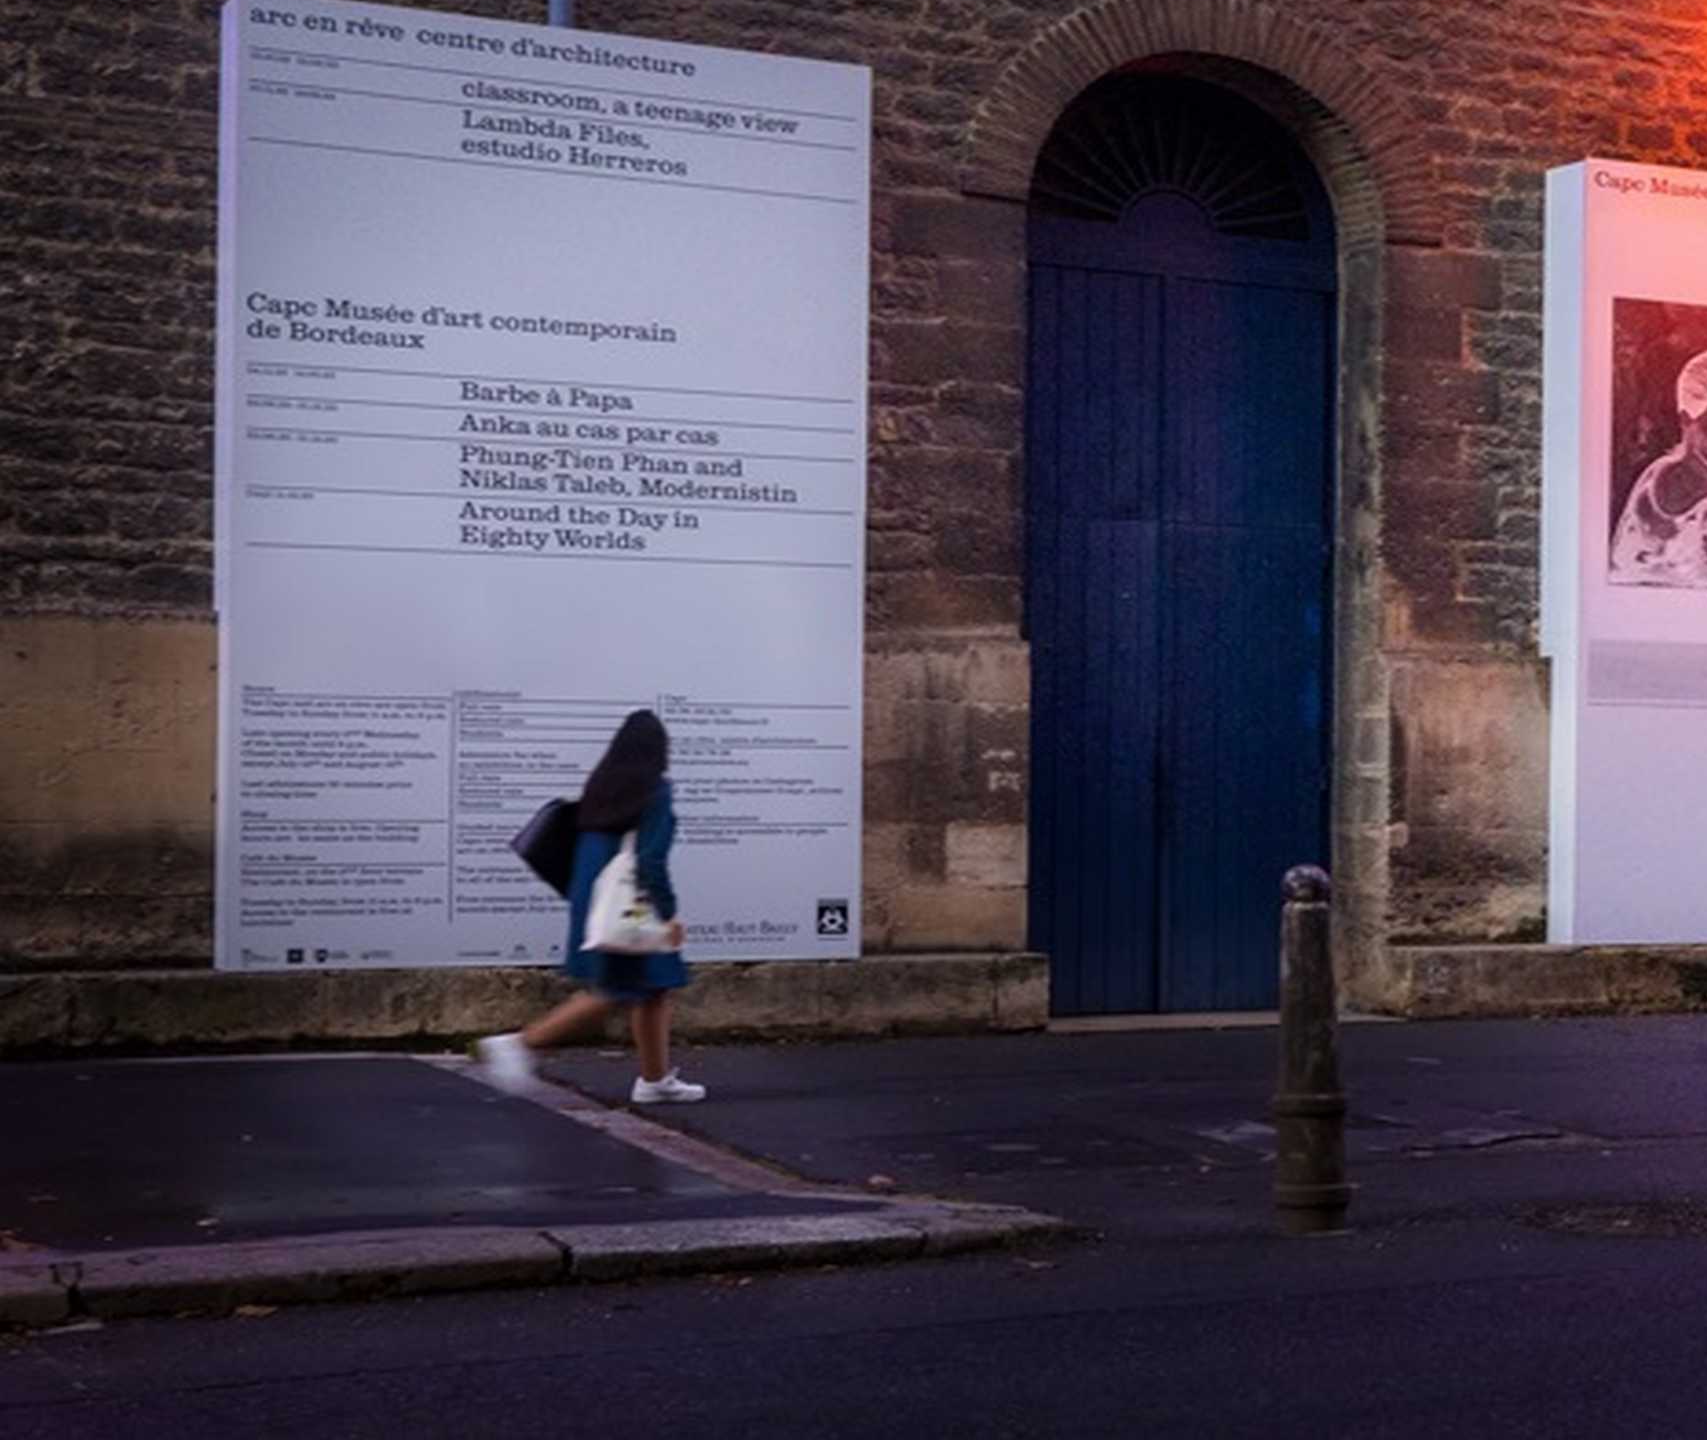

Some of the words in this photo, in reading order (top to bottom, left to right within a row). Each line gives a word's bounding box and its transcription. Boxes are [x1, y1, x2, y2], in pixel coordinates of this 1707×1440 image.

[249, 6, 297, 27] arc
[303, 14, 337, 33] en
[346, 17, 404, 41] rêve
[417, 26, 504, 55] centre
[511, 36, 696, 77] d'architecture
[462, 80, 607, 114] classroom,
[613, 100, 629, 116] a
[634, 101, 736, 135] teenage
[740, 113, 799, 134] view
[463, 109, 571, 141] Lambda
[579, 122, 651, 149] Files,
[461, 136, 561, 164] estudio
[569, 146, 687, 176] Herreros
[246, 318, 281, 340] de
[289, 322, 425, 349] Bordeaux
[325, 298, 415, 325] Musée
[422, 306, 484, 329] d'art
[490, 313, 677, 343] contemporain
[460, 381, 540, 407] Barbe
[549, 388, 561, 406] à
[569, 386, 633, 413] Papa
[459, 413, 531, 436] Anka
[537, 421, 569, 439] au
[576, 423, 620, 441] cas
[626, 425, 670, 446] par
[676, 428, 719, 447] cas
[460, 444, 614, 472] Phung-Tien
[621, 452, 687, 475] Phan
[694, 459, 743, 478] and
[459, 469, 547, 493] Niklas
[553, 473, 632, 498] Taleb,
[639, 478, 798, 504] Modernistin
[459, 500, 561, 523] Around
[568, 505, 611, 526] the
[618, 508, 668, 532] Day
[674, 510, 699, 530] in
[460, 525, 549, 551] Eighty
[555, 528, 647, 551] Worlds
